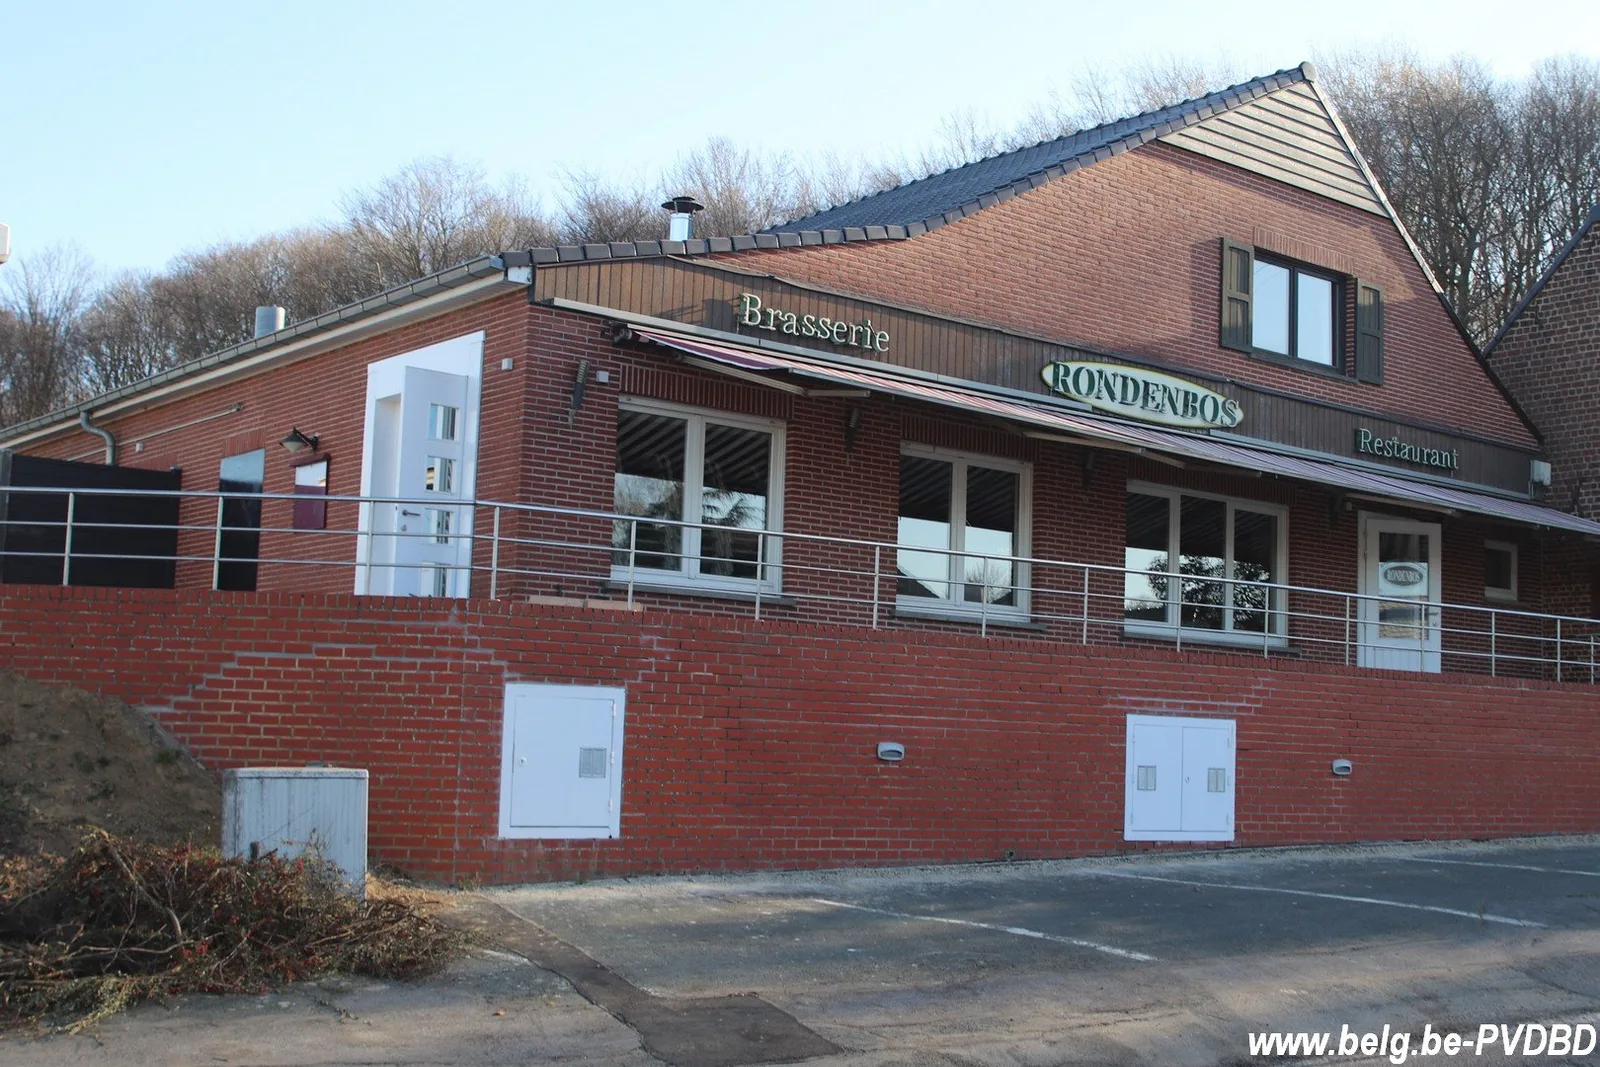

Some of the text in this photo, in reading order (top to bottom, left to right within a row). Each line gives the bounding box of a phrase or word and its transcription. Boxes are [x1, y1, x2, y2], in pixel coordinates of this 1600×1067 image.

[741, 292, 890, 352] Brasserie
[1052, 361, 1240, 428] RONDENBOS
[1357, 428, 1460, 470] Restaurant
